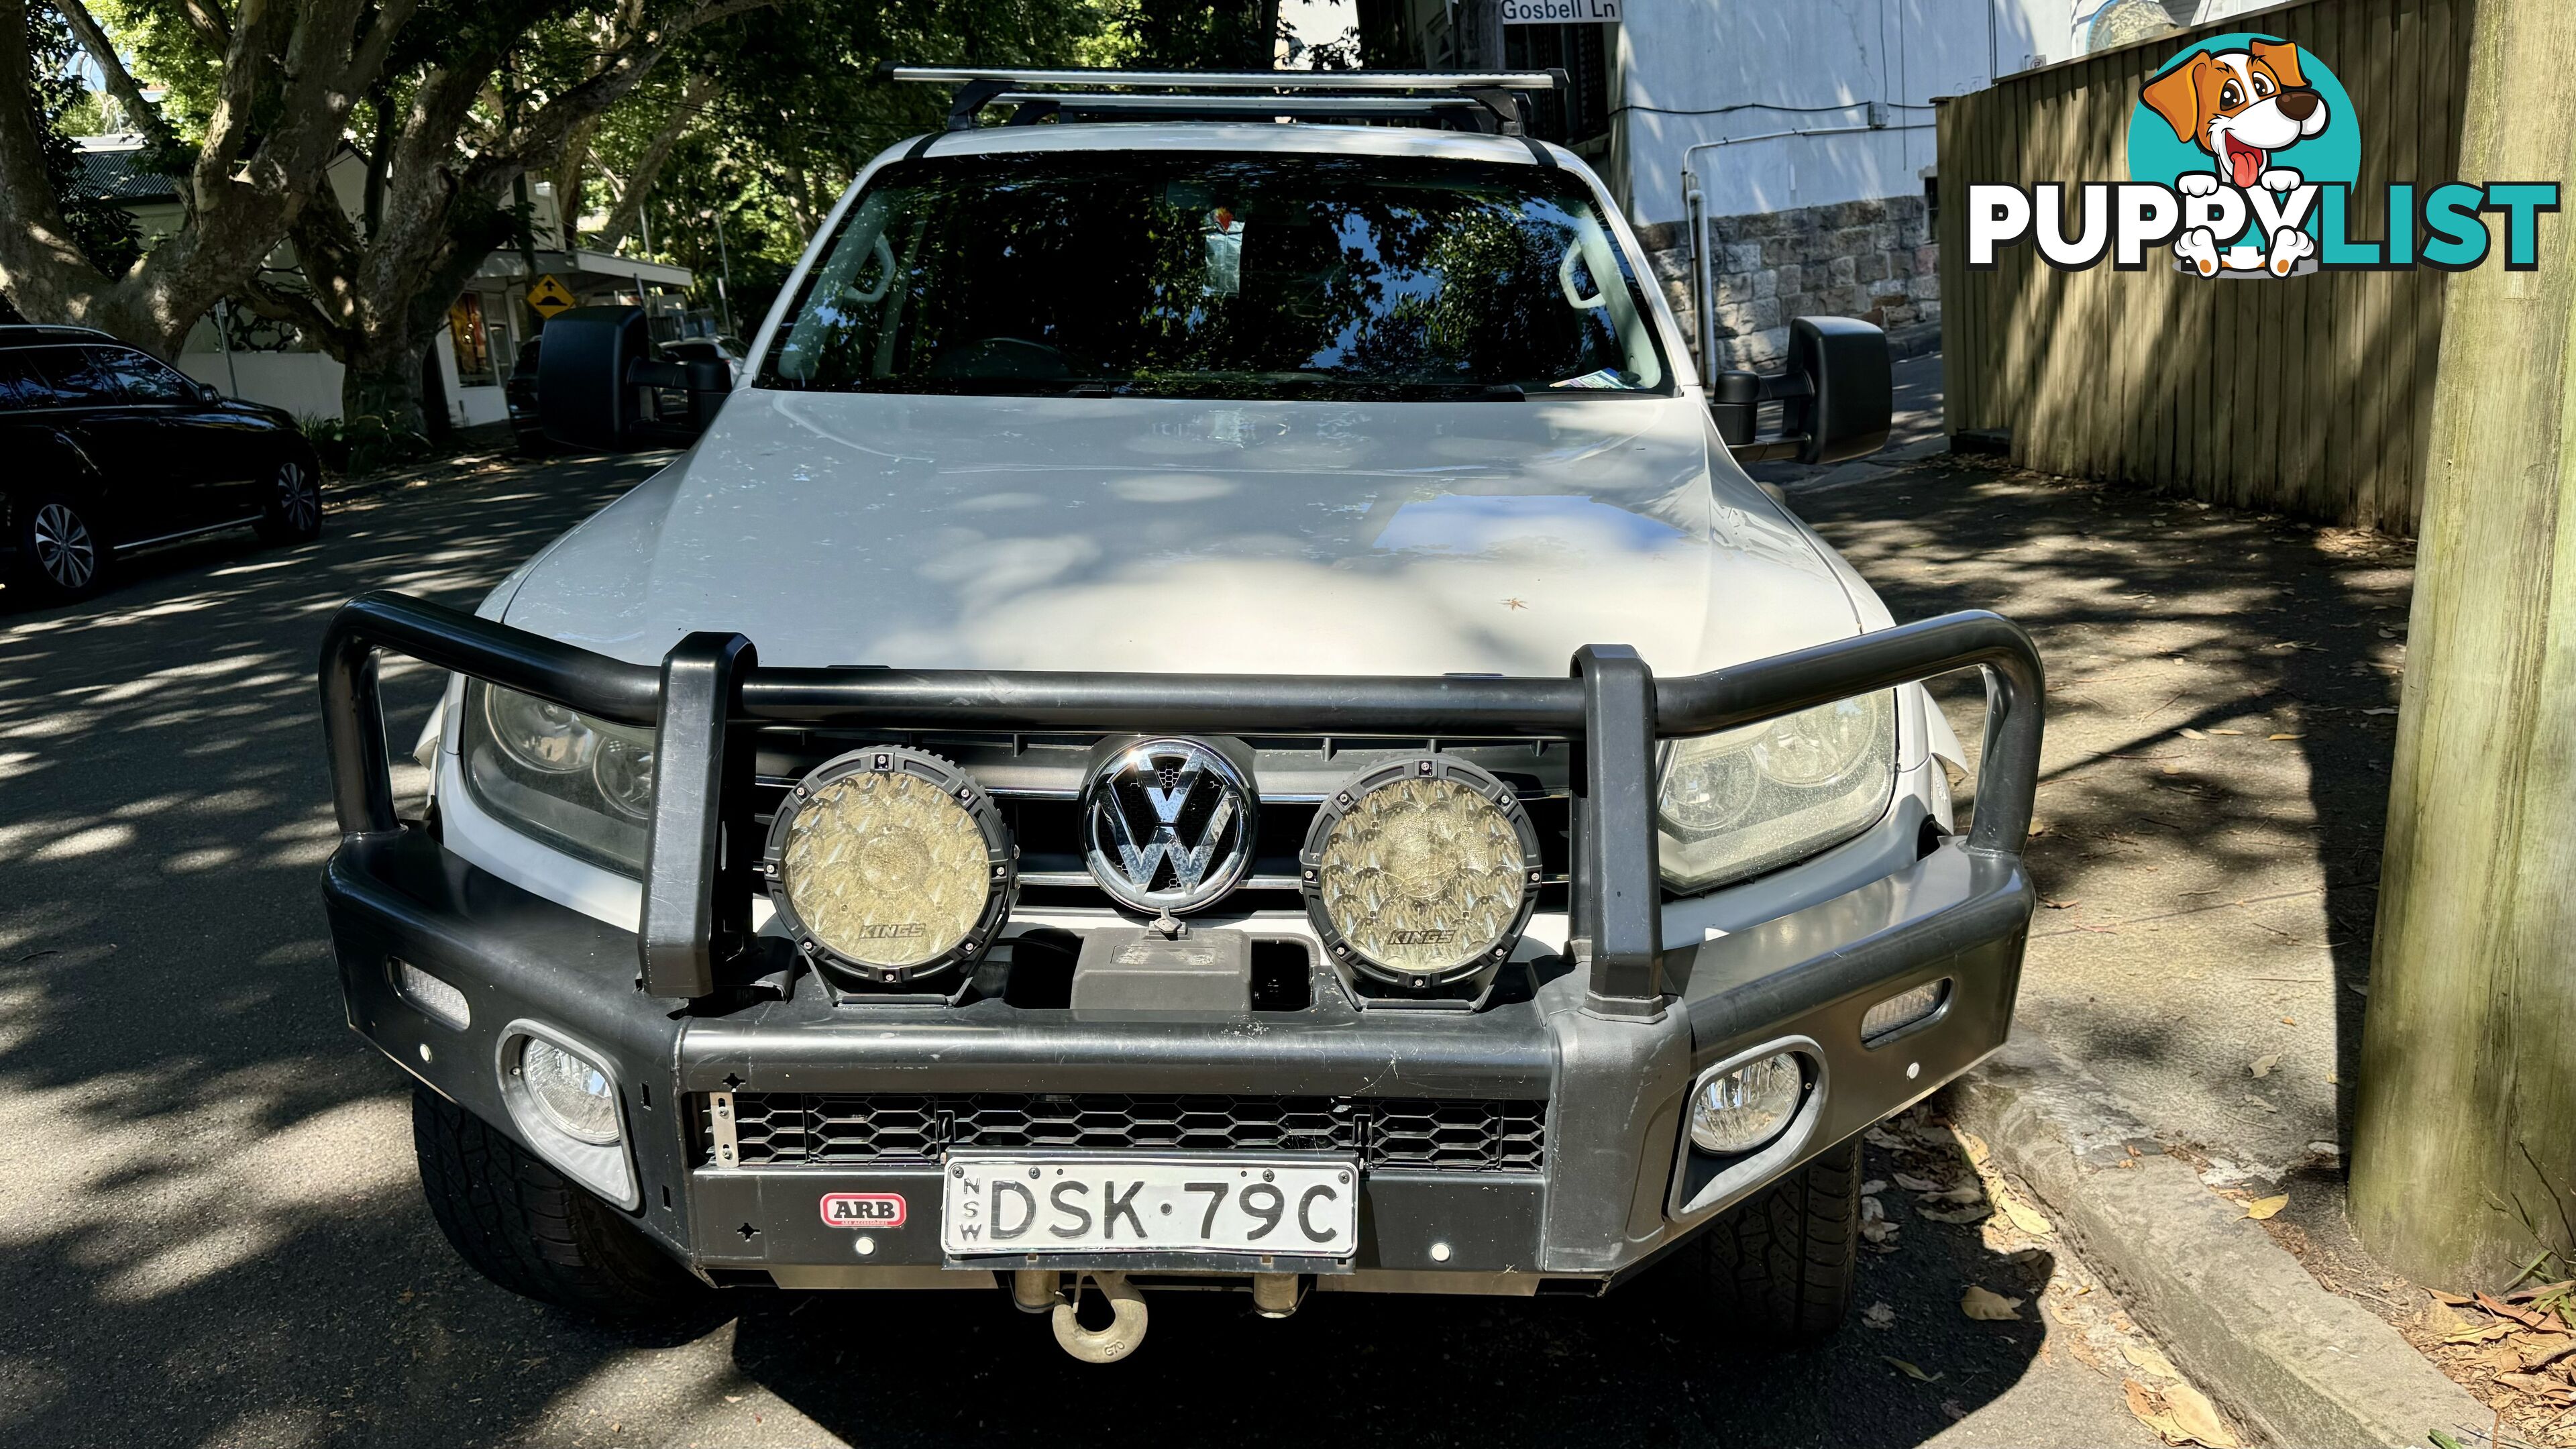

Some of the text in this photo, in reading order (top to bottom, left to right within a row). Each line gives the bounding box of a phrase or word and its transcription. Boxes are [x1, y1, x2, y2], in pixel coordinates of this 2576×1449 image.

[1501, 0, 1615, 19] Gosbell Ln
[859, 923, 926, 938] KINGS
[1387, 929, 1457, 945] KINGS
[834, 1201, 896, 1219] ARB
[959, 1177, 981, 1242] NSW
[1104, 1341, 1125, 1356] G70
